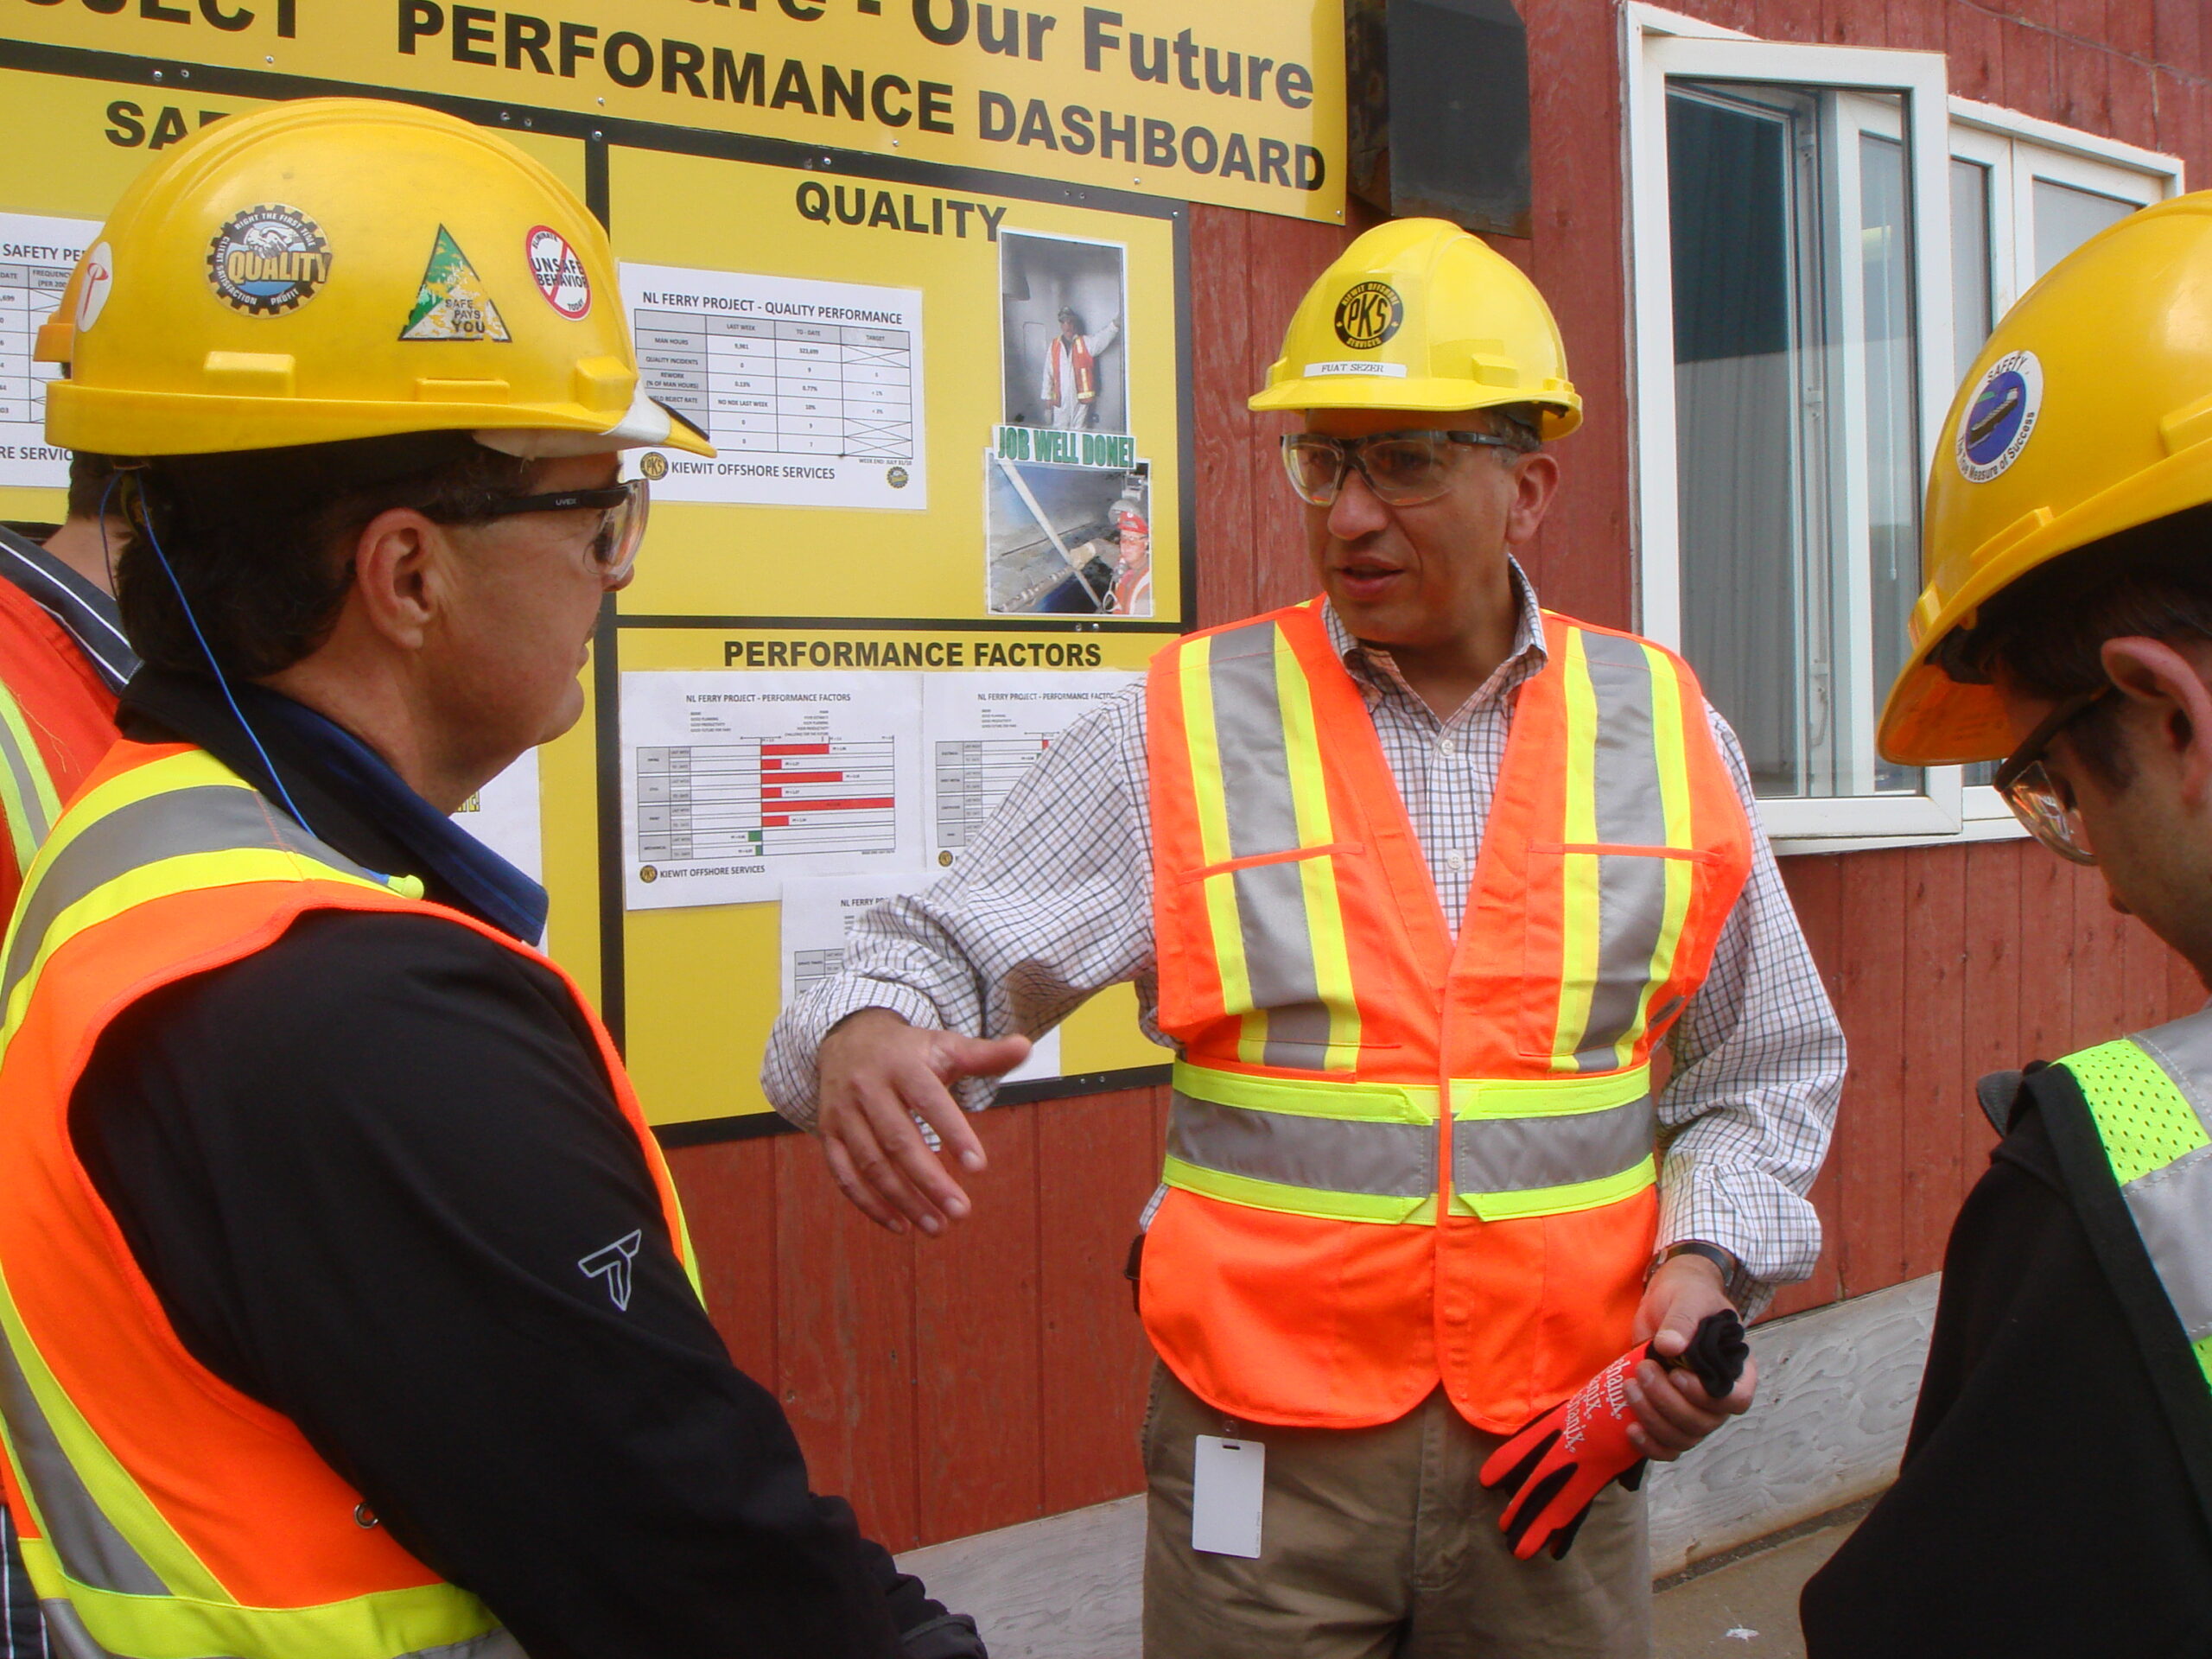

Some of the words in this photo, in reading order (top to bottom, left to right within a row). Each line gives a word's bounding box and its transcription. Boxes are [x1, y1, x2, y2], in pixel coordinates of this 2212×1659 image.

[912, 0, 1057, 61] Our
[1084, 5, 1314, 109] Future
[397, 0, 955, 135] PERFORMANCE
[978, 90, 1326, 192] DASHBOARD
[104, 100, 231, 150] SA
[795, 181, 1007, 242] QUALITY
[234, 213, 259, 231] RIGHT
[279, 213, 303, 229] FIRST
[301, 227, 316, 247] TIME
[3, 244, 59, 260] SAFETY
[63, 248, 86, 262] PE
[531, 257, 585, 275] UNSAFE
[228, 251, 333, 286] QUALITY
[270, 288, 299, 305] PROFIT
[643, 291, 659, 304] NL
[662, 293, 700, 308] FERRY
[703, 296, 754, 311] PROJECT
[765, 302, 815, 317] QUALITY
[818, 306, 903, 325] PERFORMANCE
[451, 321, 486, 334] YOU
[454, 309, 480, 320] PAYS
[1347, 293, 1388, 338] PKS
[1321, 363, 1347, 372] FUAT
[1350, 363, 1384, 372] SEZER
[998, 427, 1031, 461] JOB
[1033, 429, 1079, 465] WELL
[1082, 433, 1135, 468] DONE!
[2006, 411, 2035, 459] Success
[671, 461, 715, 474] KIEWIT
[718, 463, 779, 477] OFFSHORE
[782, 466, 836, 479] SERVICES
[724, 640, 963, 667] PERFORMANCE
[974, 642, 1102, 667] FACTORS
[686, 694, 696, 702] NL
[698, 694, 721, 703] FERRY
[723, 694, 755, 702] PROJECT
[762, 693, 817, 702] PERFORMANCE
[819, 693, 851, 702] FACTORS
[659, 868, 688, 879] KIEWIT
[690, 867, 729, 876] OFFSHORE
[730, 865, 766, 875] SERVICES
[841, 899, 850, 907] NL
[852, 898, 874, 906] FERRY
